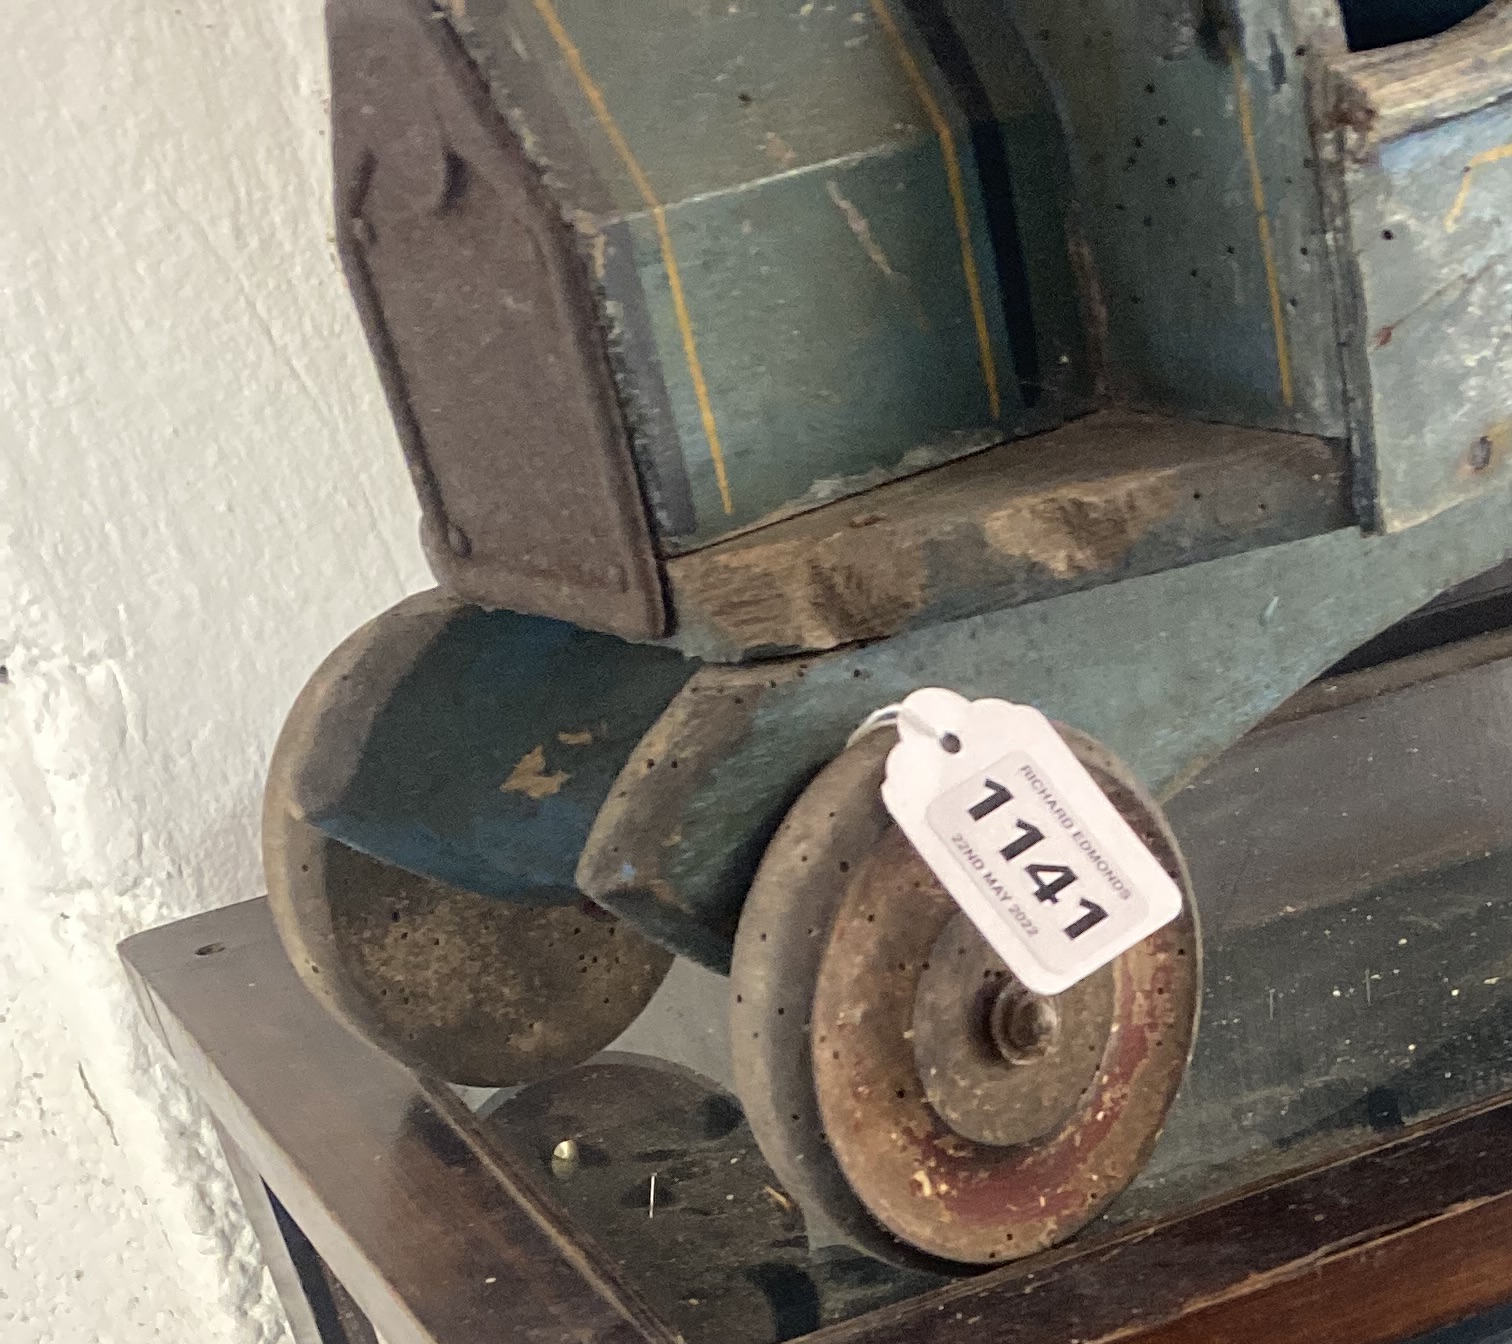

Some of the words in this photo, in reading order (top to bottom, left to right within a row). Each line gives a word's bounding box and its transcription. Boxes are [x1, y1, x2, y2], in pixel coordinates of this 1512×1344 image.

[951, 833, 985, 872] 22ND
[983, 871, 1011, 903] MAY
[1008, 903, 1039, 938] 2022
[967, 778, 1109, 941] 1141
[1018, 764, 1074, 831] RICHARD
[1072, 830, 1133, 901] EDMONDS
